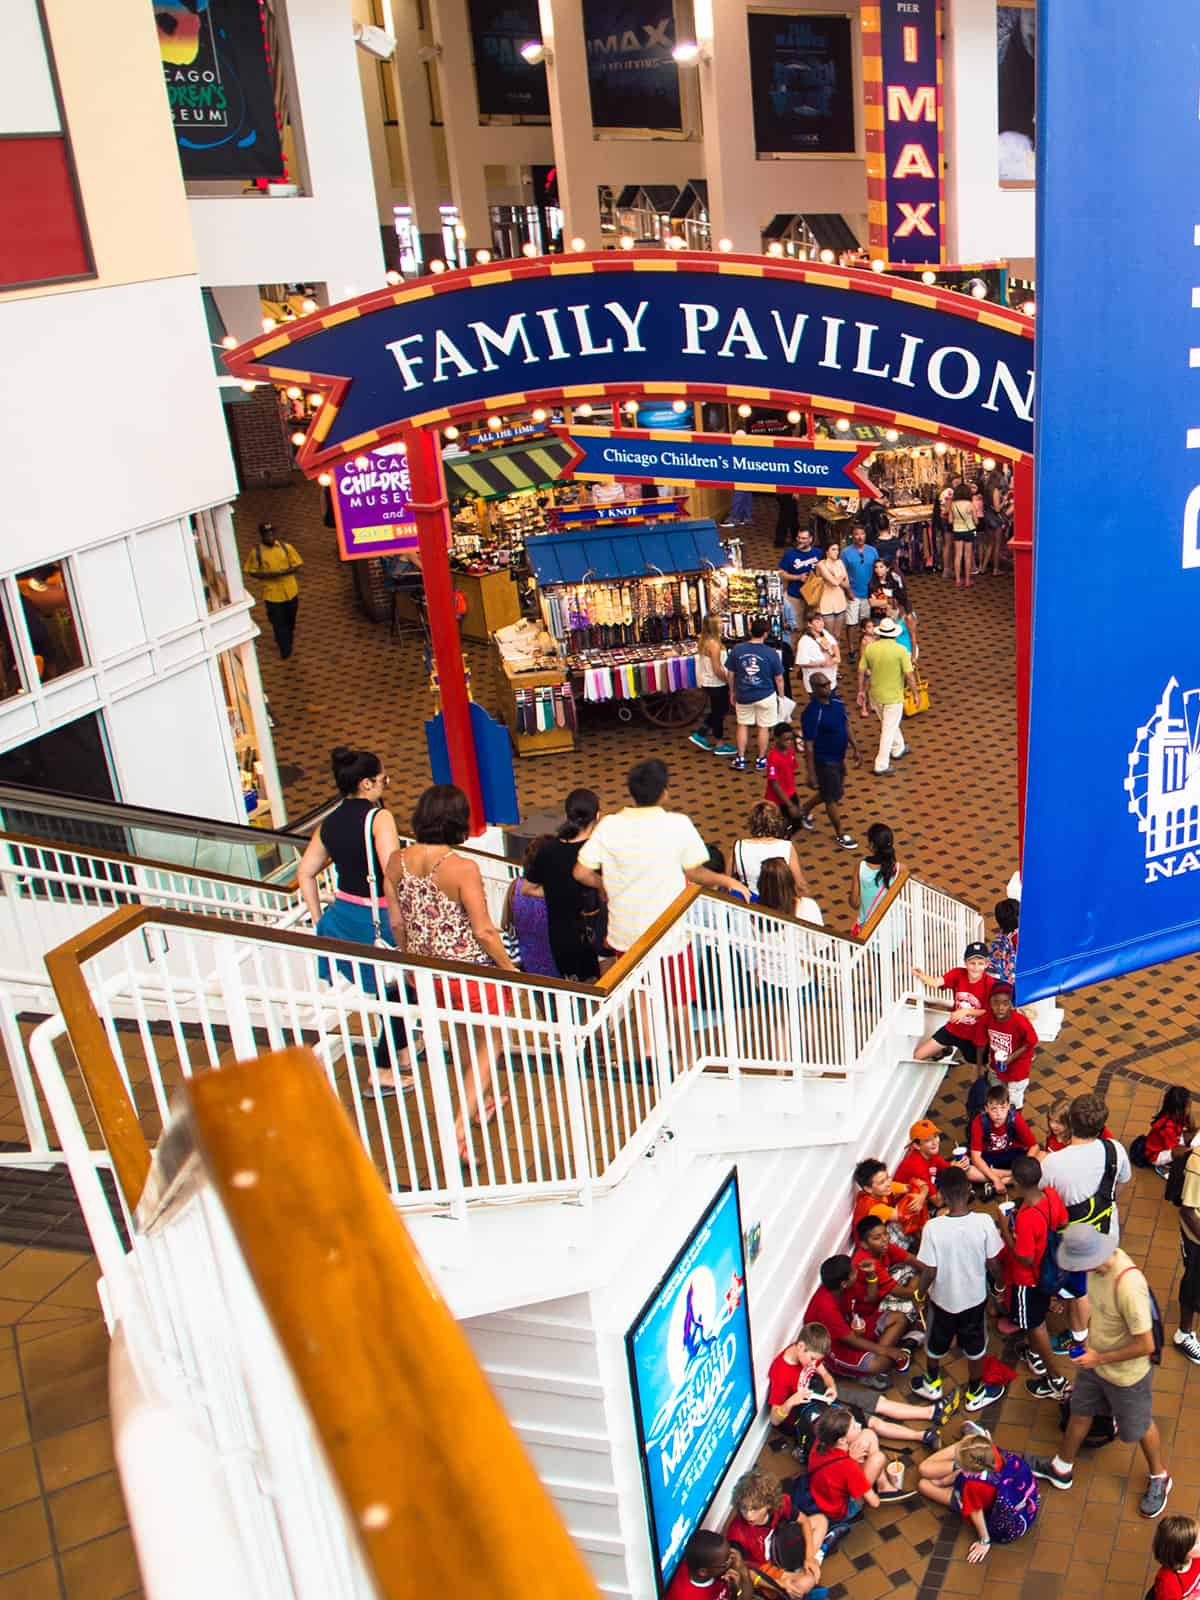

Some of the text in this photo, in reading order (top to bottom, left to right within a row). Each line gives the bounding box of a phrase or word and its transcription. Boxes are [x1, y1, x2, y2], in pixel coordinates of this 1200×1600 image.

[897, 2, 920, 13] PIER
[886, 26, 938, 237] IMAX
[385, 300, 1035, 421] FAMILY PAVILION
[603, 448, 829, 475] Chicago Children's Museum Store
[382, 507, 404, 519] and
[660, 1332, 737, 1488] MERMAID
